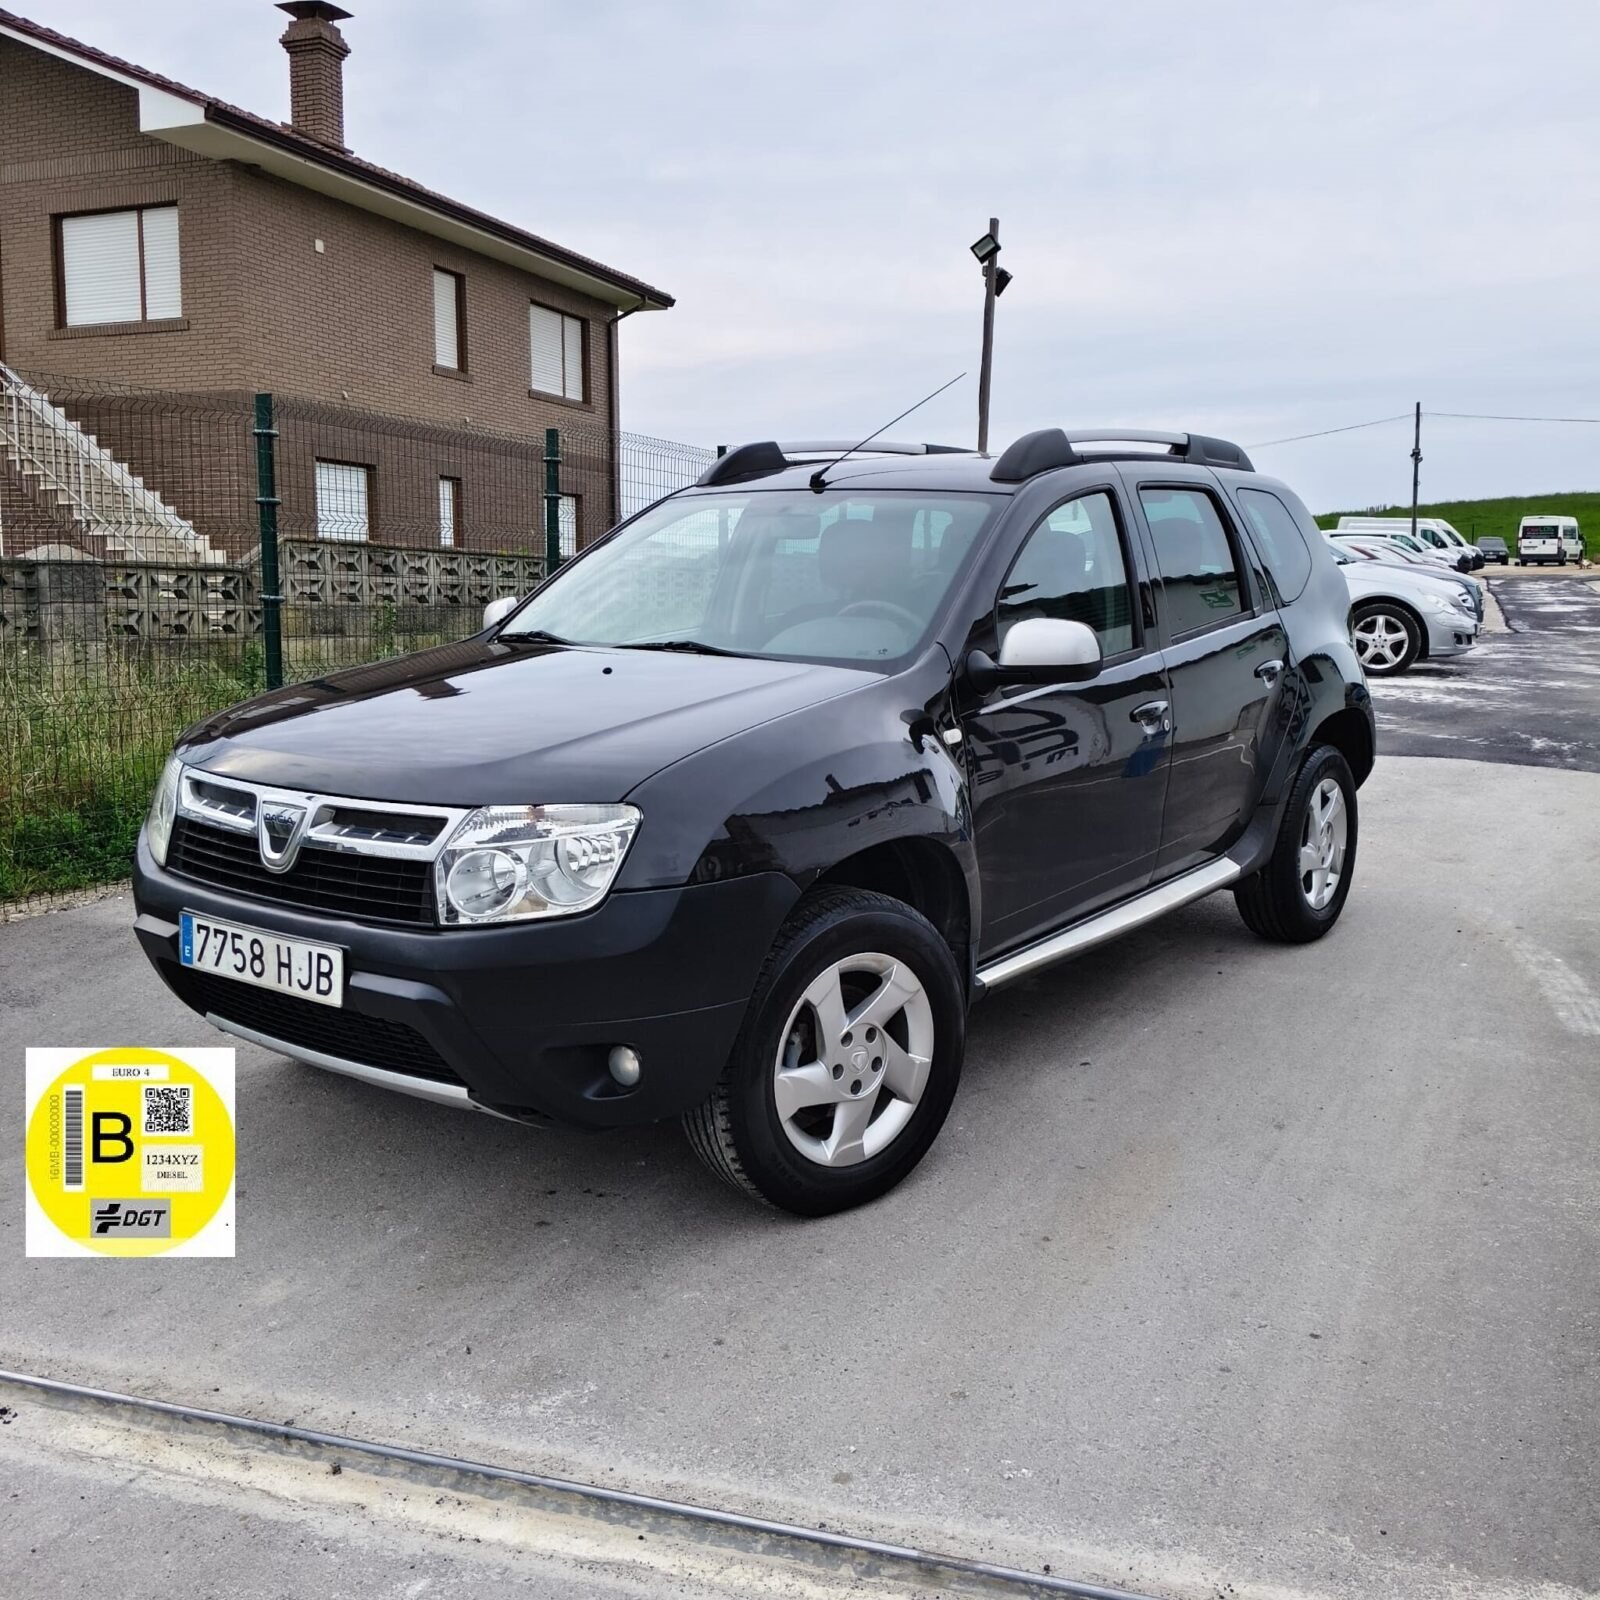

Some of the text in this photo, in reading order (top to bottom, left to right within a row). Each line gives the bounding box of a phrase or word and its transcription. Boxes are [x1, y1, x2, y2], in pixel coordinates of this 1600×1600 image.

[184, 945, 192, 958] E
[196, 923, 334, 996] 7758 HJB
